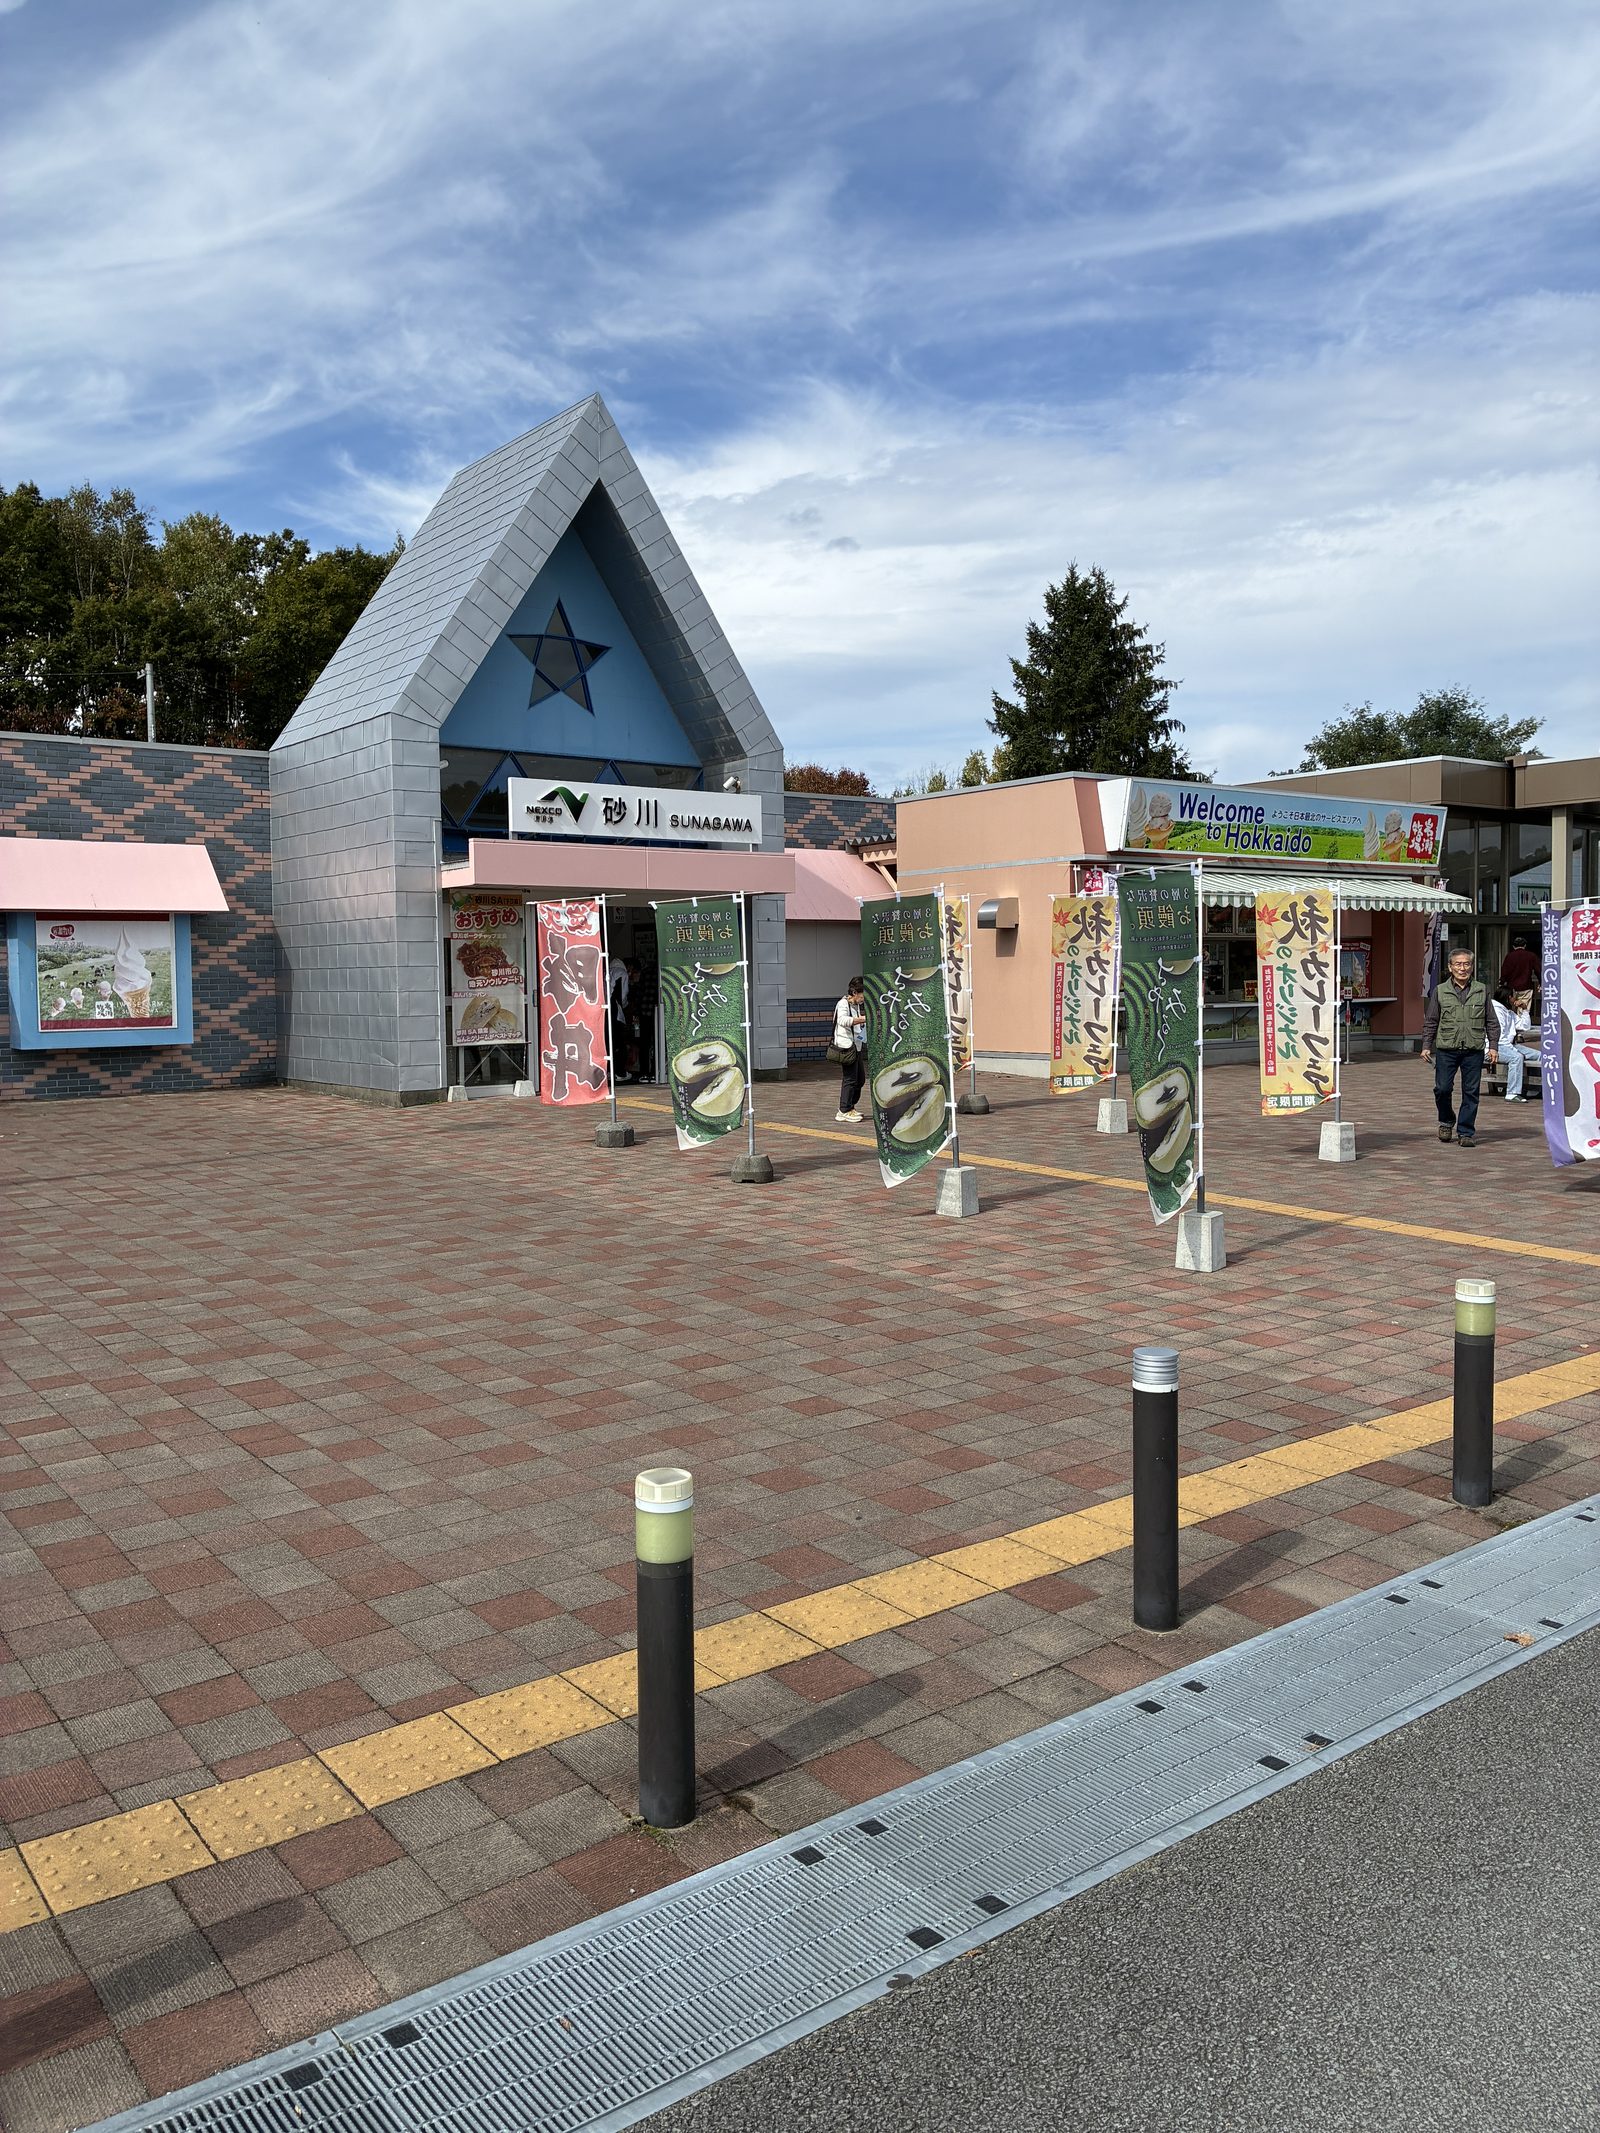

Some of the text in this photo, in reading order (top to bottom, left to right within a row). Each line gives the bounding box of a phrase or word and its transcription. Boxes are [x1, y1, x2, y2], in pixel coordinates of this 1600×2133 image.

[526, 805, 563, 817] NEXCO
[602, 796, 658, 828] 砂川
[1178, 791, 1266, 823] Welcome
[670, 814, 753, 833] SUNAGAWA
[1206, 823, 1312, 854] to Hokkaido
[455, 907, 519, 930] おすすめ
